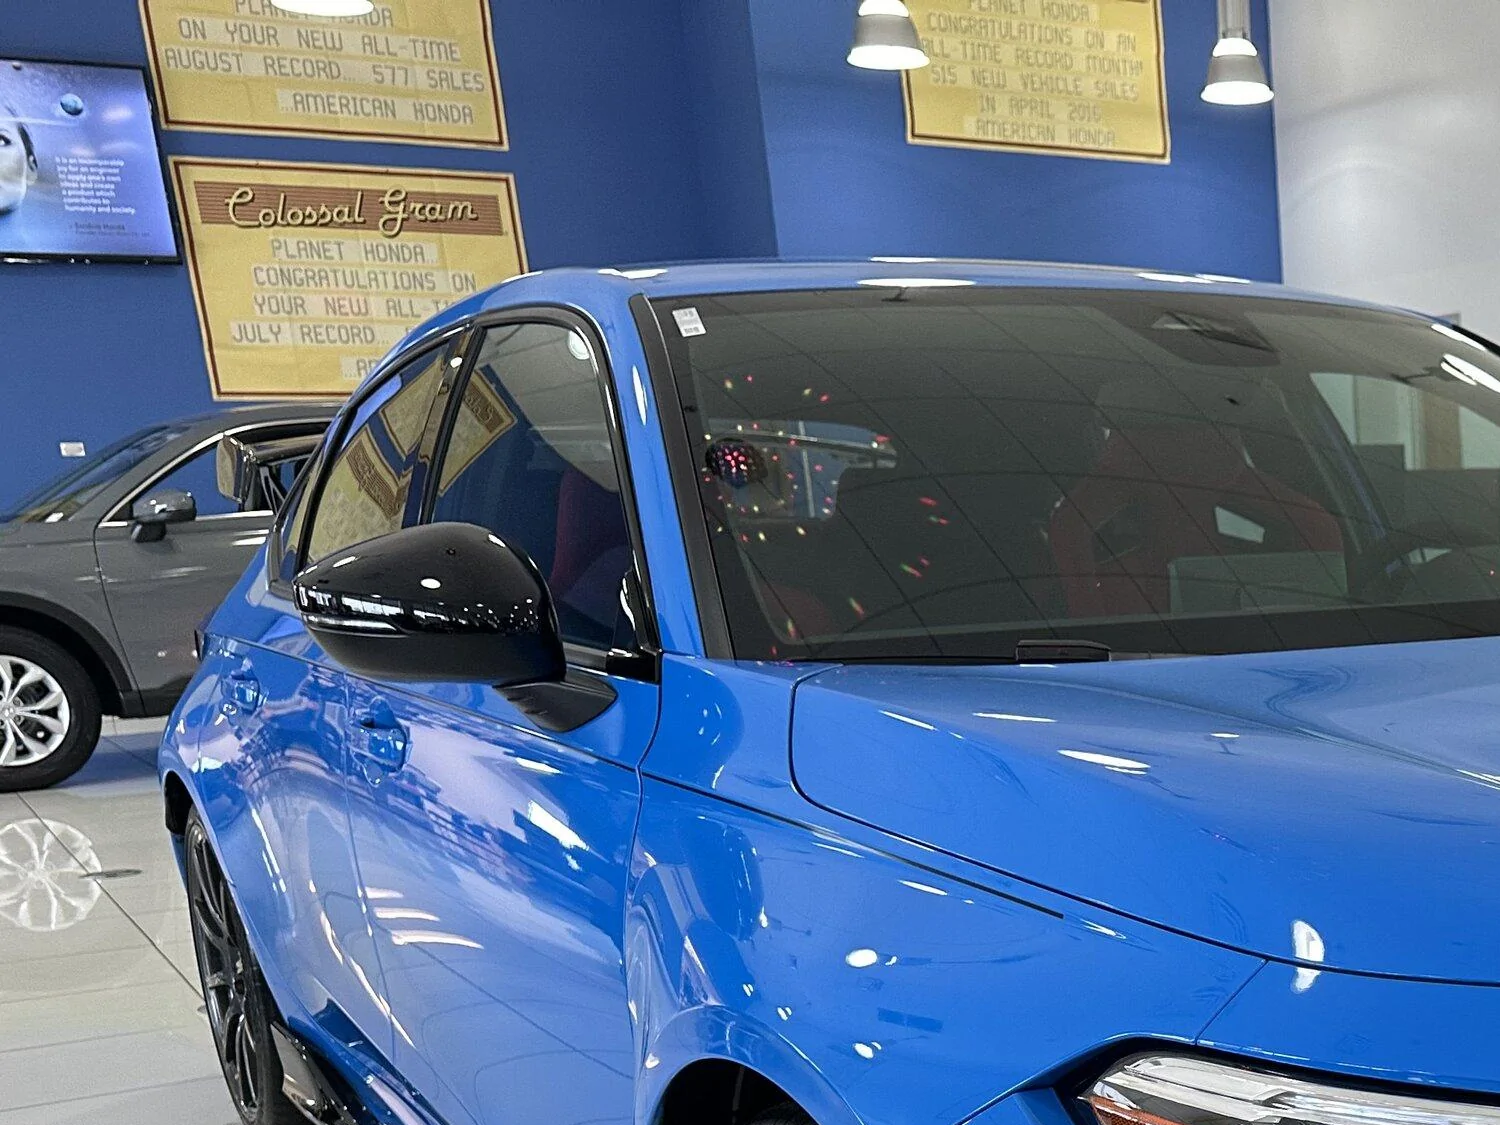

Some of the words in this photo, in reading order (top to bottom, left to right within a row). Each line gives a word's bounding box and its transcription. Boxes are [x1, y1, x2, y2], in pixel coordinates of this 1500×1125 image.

[234, 0, 311, 20] PLA
[331, 8, 394, 28] NDA
[178, 18, 207, 41] ON
[225, 22, 280, 48] YOUR
[297, 29, 344, 52] NEW
[361, 35, 461, 62] ALL-TIME
[926, 11, 1073, 46] CONGRATULATIONS
[1084, 31, 1105, 49] ON
[1117, 33, 1137, 52] AN
[165, 48, 243, 73] AUGUST
[372, 65, 409, 86] 577
[426, 70, 486, 92] SALES
[1014, 48, 1074, 71] RECORD
[971, 68, 1007, 88] NEW
[1019, 72, 1083, 95] VEHICLE
[1093, 81, 1138, 100] SALES
[413, 103, 474, 125] HONDA
[979, 95, 997, 114] IN
[1008, 97, 1055, 118] APRIL
[1067, 128, 1116, 147] HONDA
[225, 187, 367, 227] Colossal
[378, 189, 479, 237] Gram
[271, 239, 346, 261] PLANET
[253, 266, 437, 292] CONGRATULATIONS
[451, 273, 477, 292] ON
[254, 296, 307, 317] YOUR
[325, 298, 369, 318] NEW
[232, 324, 284, 344] JULY
